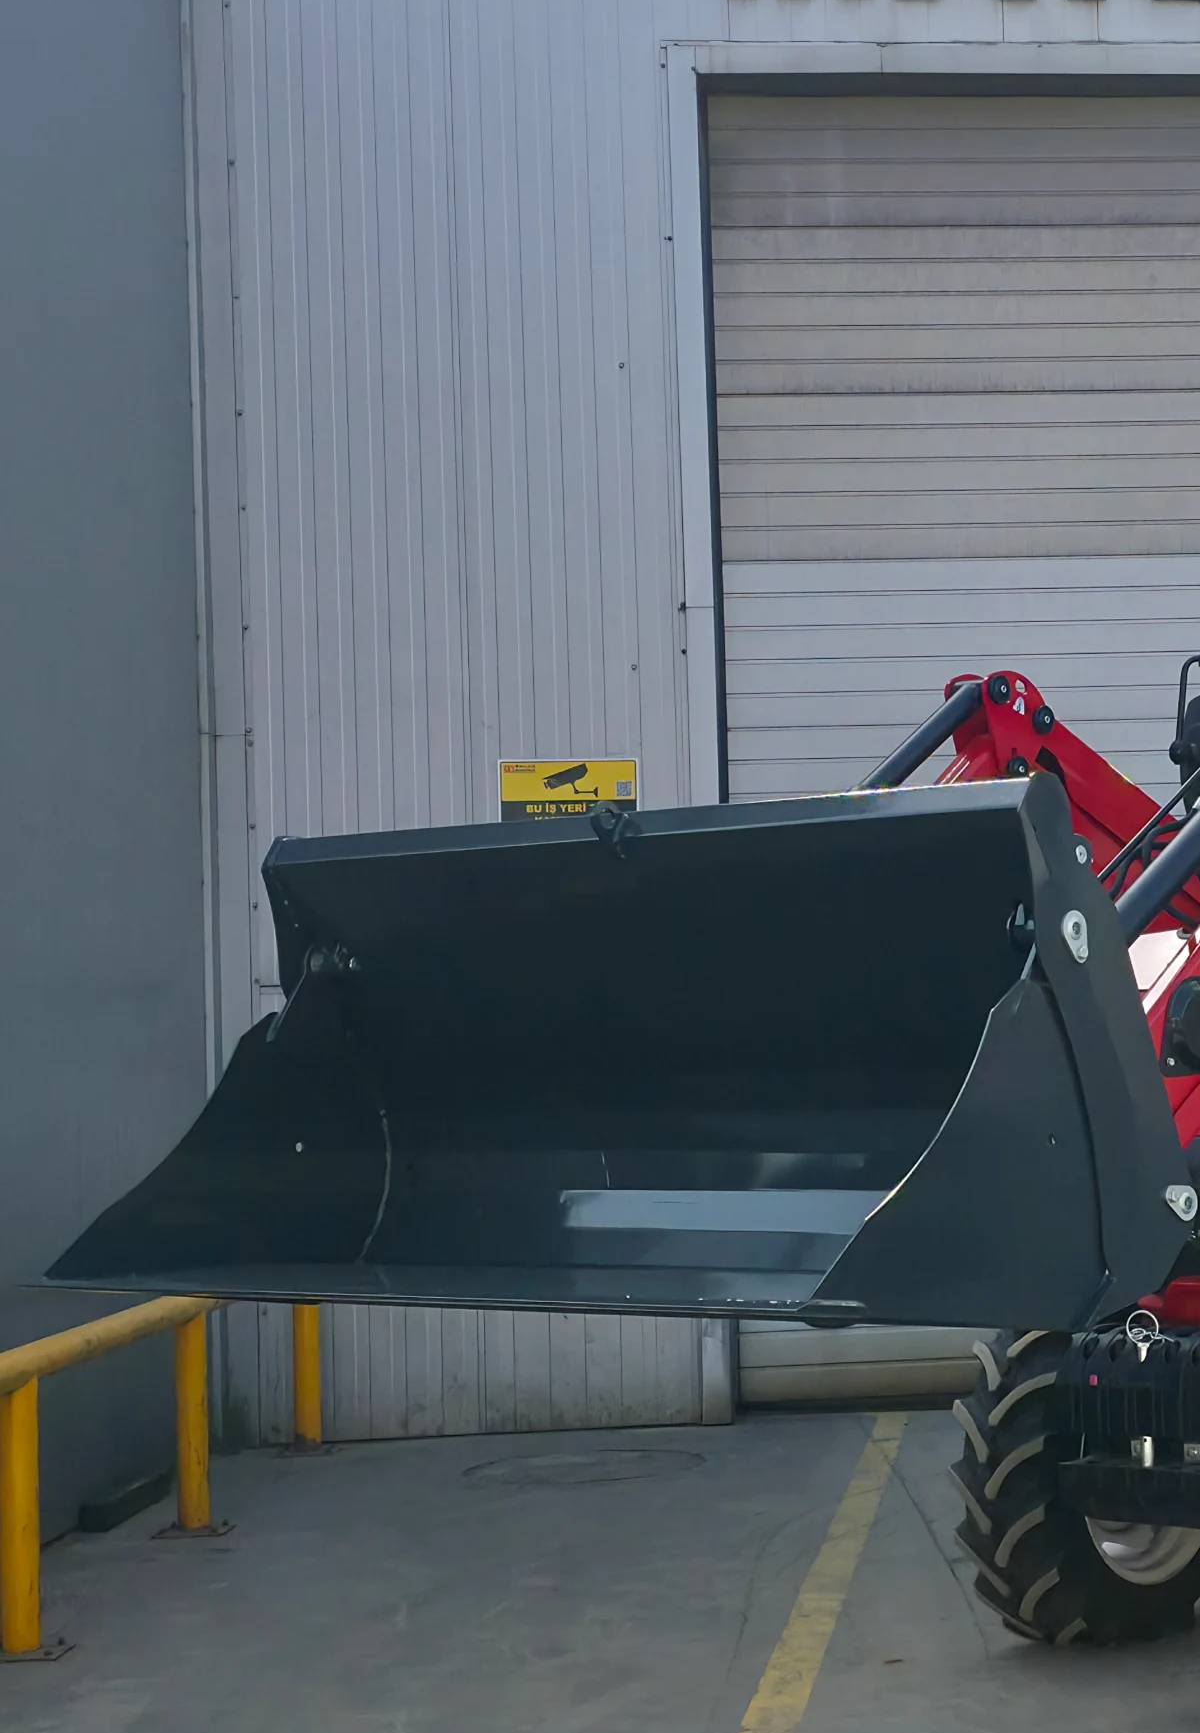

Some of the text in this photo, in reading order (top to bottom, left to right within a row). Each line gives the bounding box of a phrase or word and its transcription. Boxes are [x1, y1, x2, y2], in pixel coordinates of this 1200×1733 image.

[526, 802, 586, 814] BU İŞ YERİ
